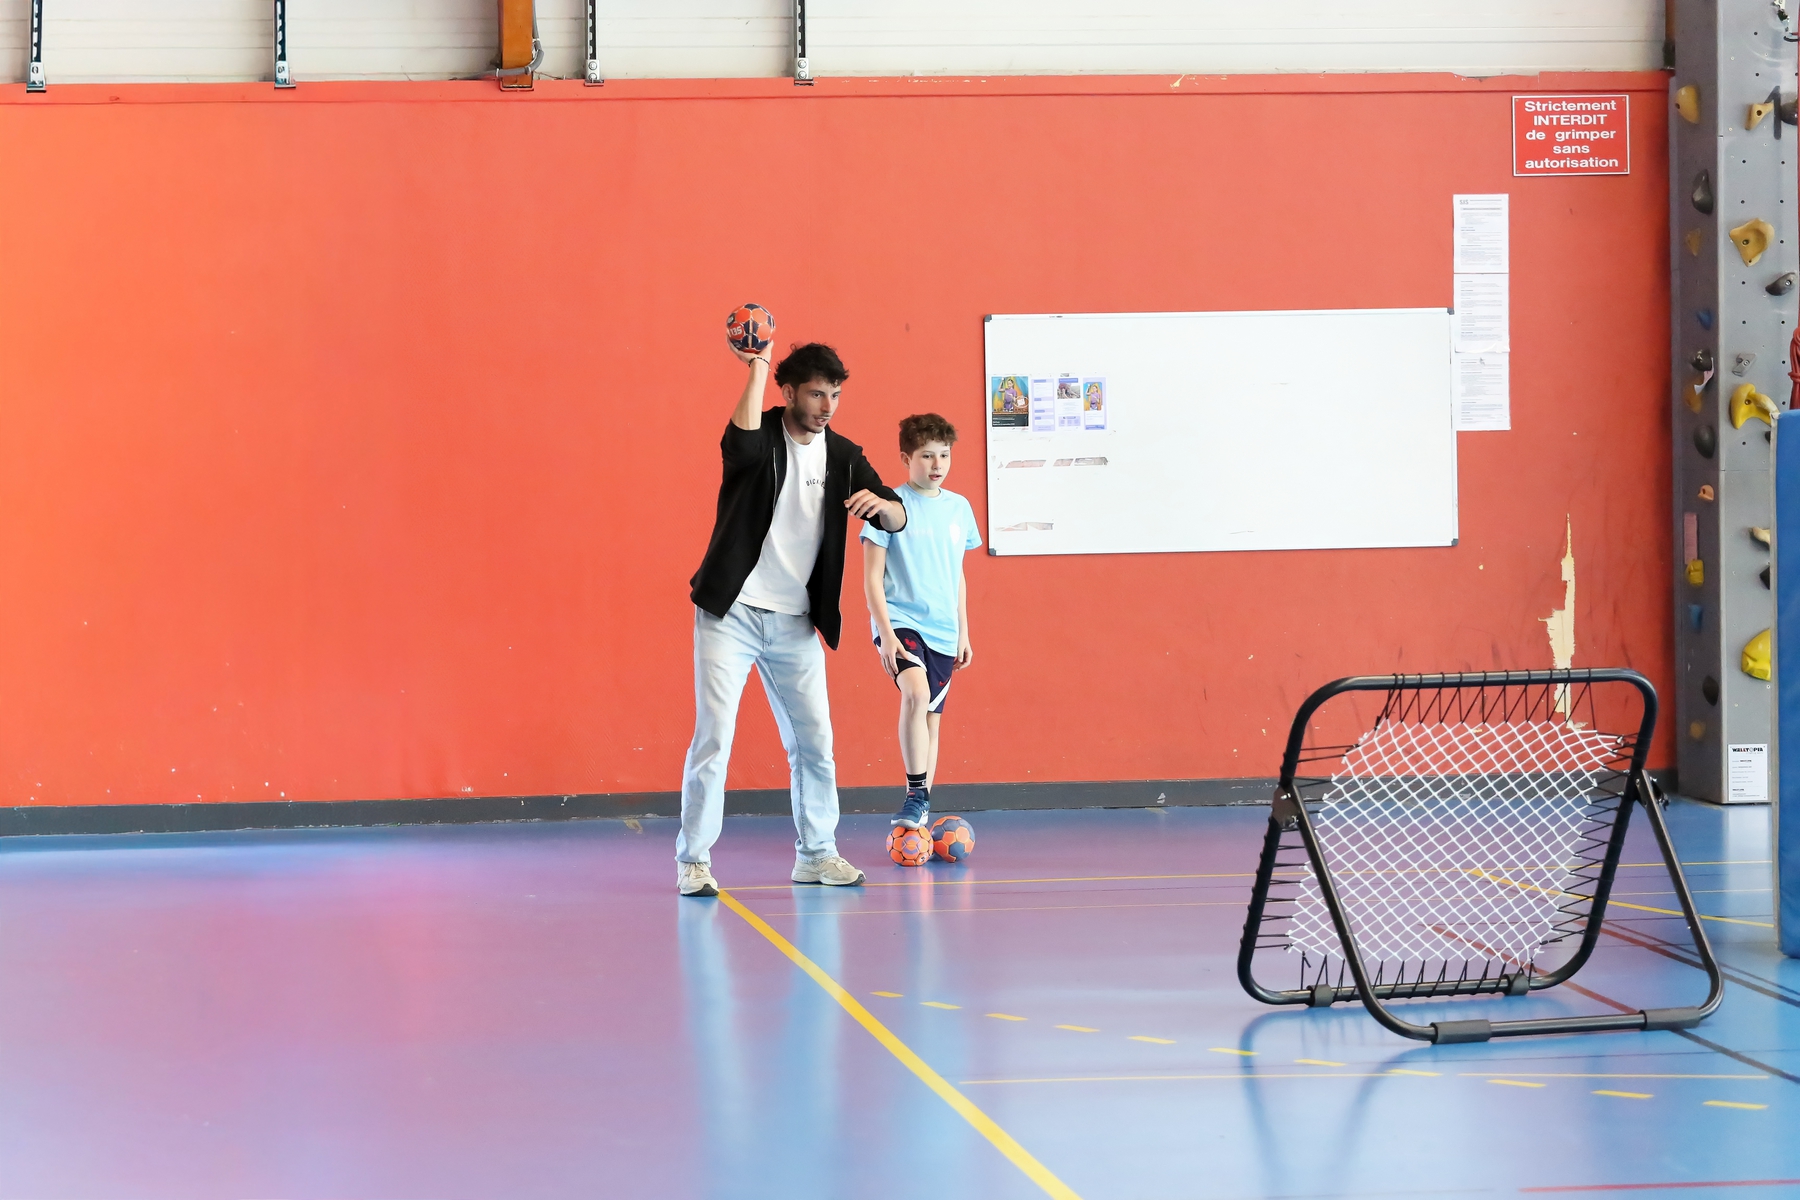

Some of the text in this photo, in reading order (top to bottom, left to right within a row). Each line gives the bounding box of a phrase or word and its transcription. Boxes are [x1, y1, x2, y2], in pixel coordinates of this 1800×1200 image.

[1524, 100, 1617, 112] Strictement
[1533, 114, 1607, 126] INTERDIT
[1525, 129, 1616, 141] de grimper
[1553, 145, 1590, 154] sans
[1525, 157, 1619, 169] autorisation
